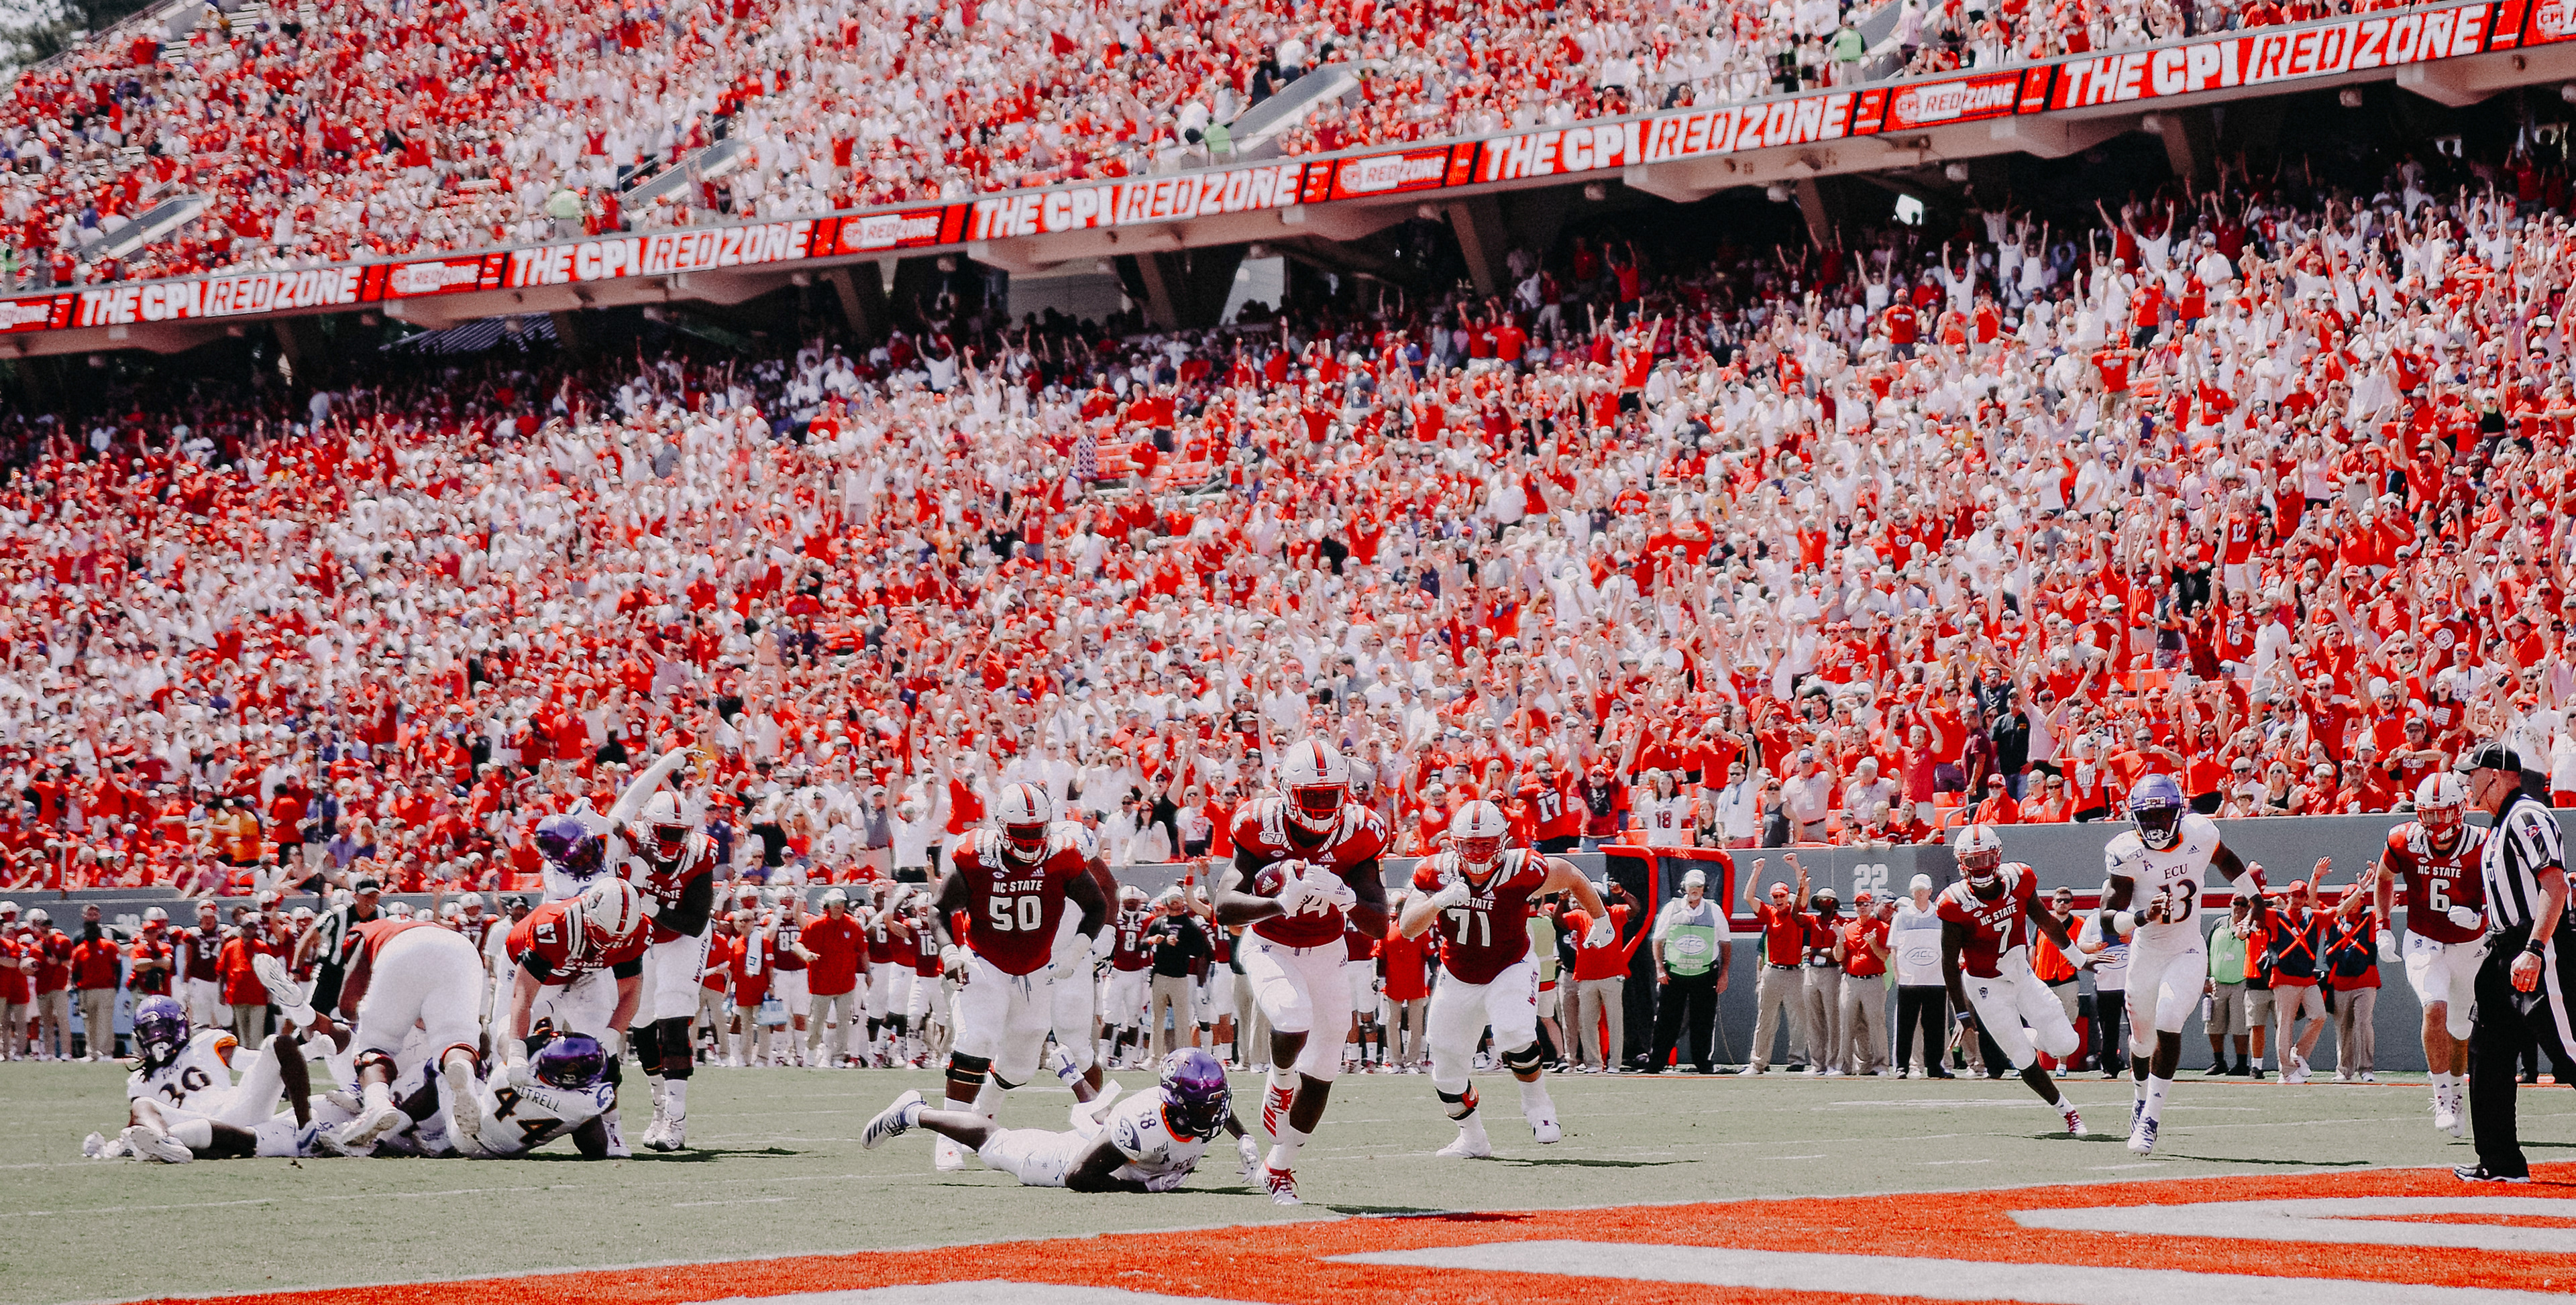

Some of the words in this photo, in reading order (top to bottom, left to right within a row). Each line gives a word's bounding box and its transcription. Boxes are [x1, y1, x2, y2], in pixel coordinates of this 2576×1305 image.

[2540, 13, 2563, 24] CPI
[2064, 54, 2147, 108] THE
[2151, 39, 2239, 95] CPI
[1487, 133, 1561, 181] THE
[1562, 121, 1642, 172] CPI
[975, 192, 1044, 240] THE
[1043, 187, 1114, 232] CPI
[513, 243, 578, 288] THE
[574, 237, 642, 281] CPI
[80, 288, 141, 327] THE
[140, 282, 203, 321] CPI
[2232, 524, 2247, 543] 12
[1537, 792, 1562, 824] 17
[1655, 811, 1672, 829] 18
[1259, 832, 1283, 845] 150
[1854, 863, 1889, 894] 22
[2164, 863, 2188, 880] ECU
[2418, 865, 2430, 875] NC
[2432, 866, 2461, 878] STATE
[993, 881, 1007, 893] NC
[1009, 879, 1043, 893] STATE
[2430, 878, 2451, 913] 6
[989, 895, 1042, 931] 50
[1980, 914, 1992, 927] NC
[1993, 903, 2018, 921] STATE
[1446, 907, 1491, 948] 71
[1993, 917, 2012, 954] 7
[920, 935, 938, 956] 16
[1123, 931, 1137, 952] 8
[1678, 938, 1703, 948] ACC
[1911, 951, 1935, 960] ACC
[494, 1087, 566, 1145] 44
[1171, 1154, 1197, 1172] ECU
